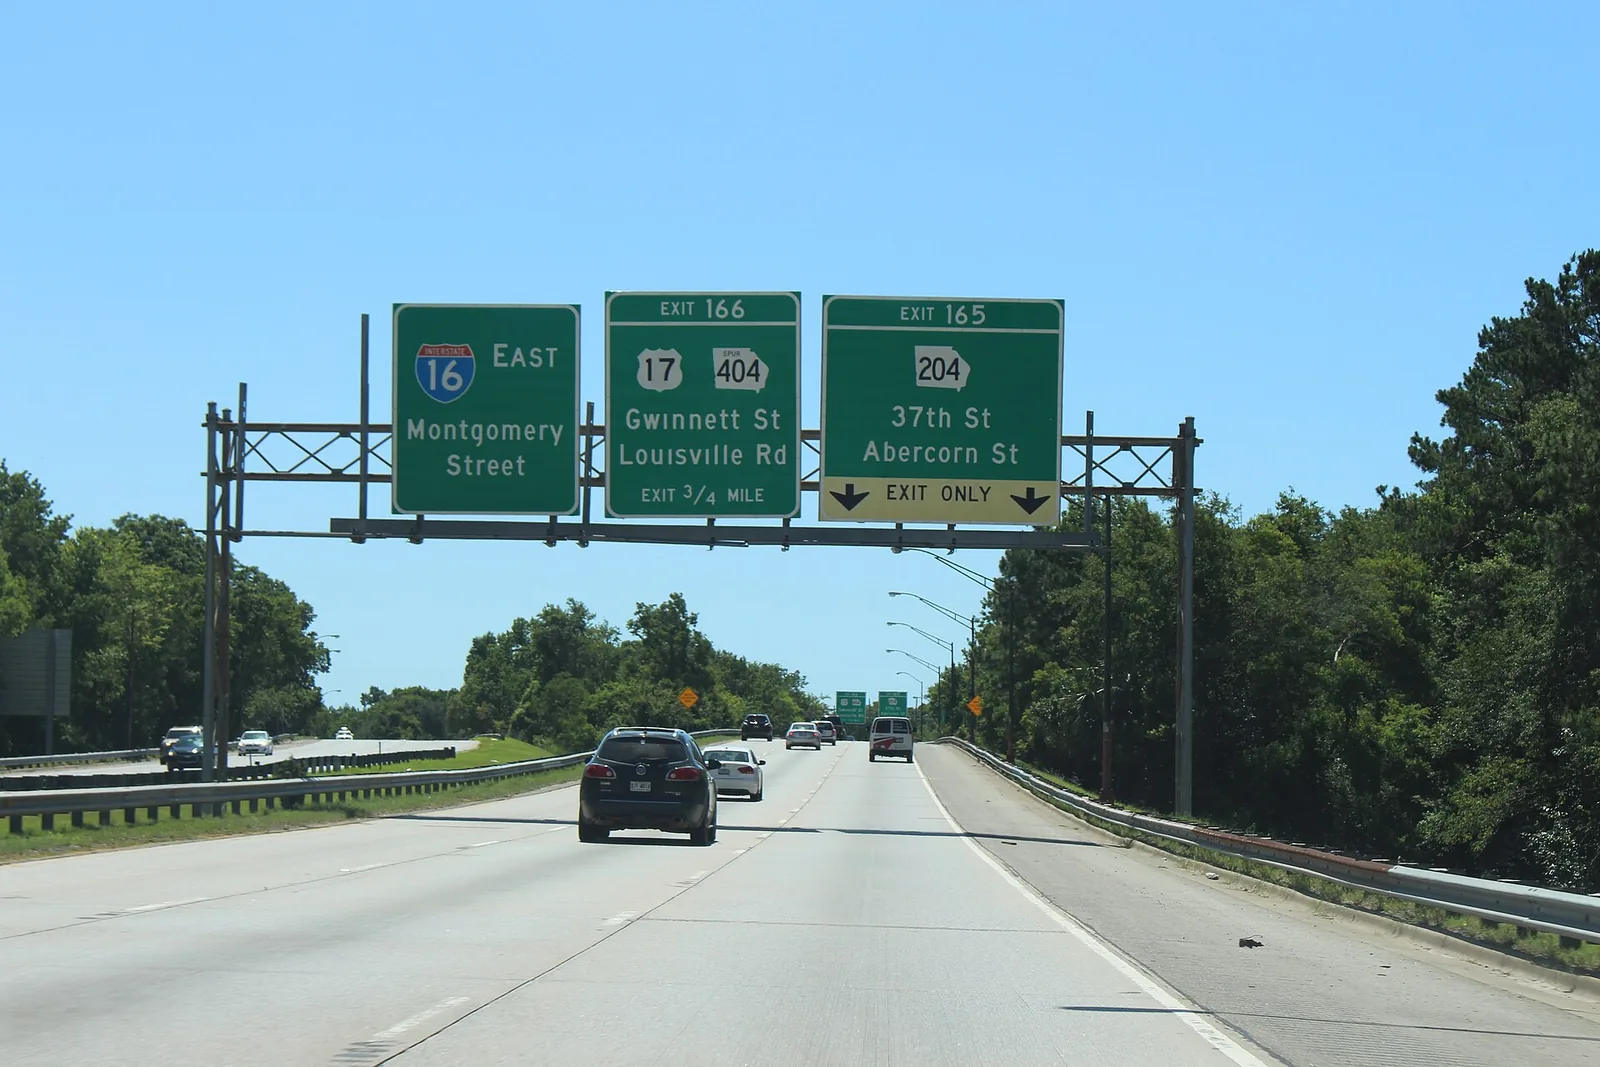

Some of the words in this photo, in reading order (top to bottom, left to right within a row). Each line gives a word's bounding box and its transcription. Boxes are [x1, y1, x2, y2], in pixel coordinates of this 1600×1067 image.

[660, 302, 694, 316] EXIT
[706, 299, 745, 319] 166
[900, 307, 935, 321] EXIT
[946, 304, 986, 325] 165
[424, 347, 466, 355] INTERSTATE
[493, 343, 558, 368] EAST
[427, 359, 463, 392] 16
[645, 357, 676, 382] 17
[716, 358, 761, 383] 404
[918, 356, 961, 381] 204
[625, 408, 740, 430] Gwinnett
[754, 408, 780, 430] St
[891, 406, 951, 428] 37th
[964, 407, 991, 429] St
[407, 419, 564, 447] Montgomery
[619, 443, 743, 465] Louisville
[756, 443, 787, 465] Rd
[863, 440, 978, 464] Abercorn
[991, 443, 1018, 465] St
[446, 454, 526, 476] Street
[641, 488, 676, 502] EXIT
[728, 488, 765, 503] MILE
[887, 485, 928, 501] EXIT
[941, 486, 991, 502] ONLY
